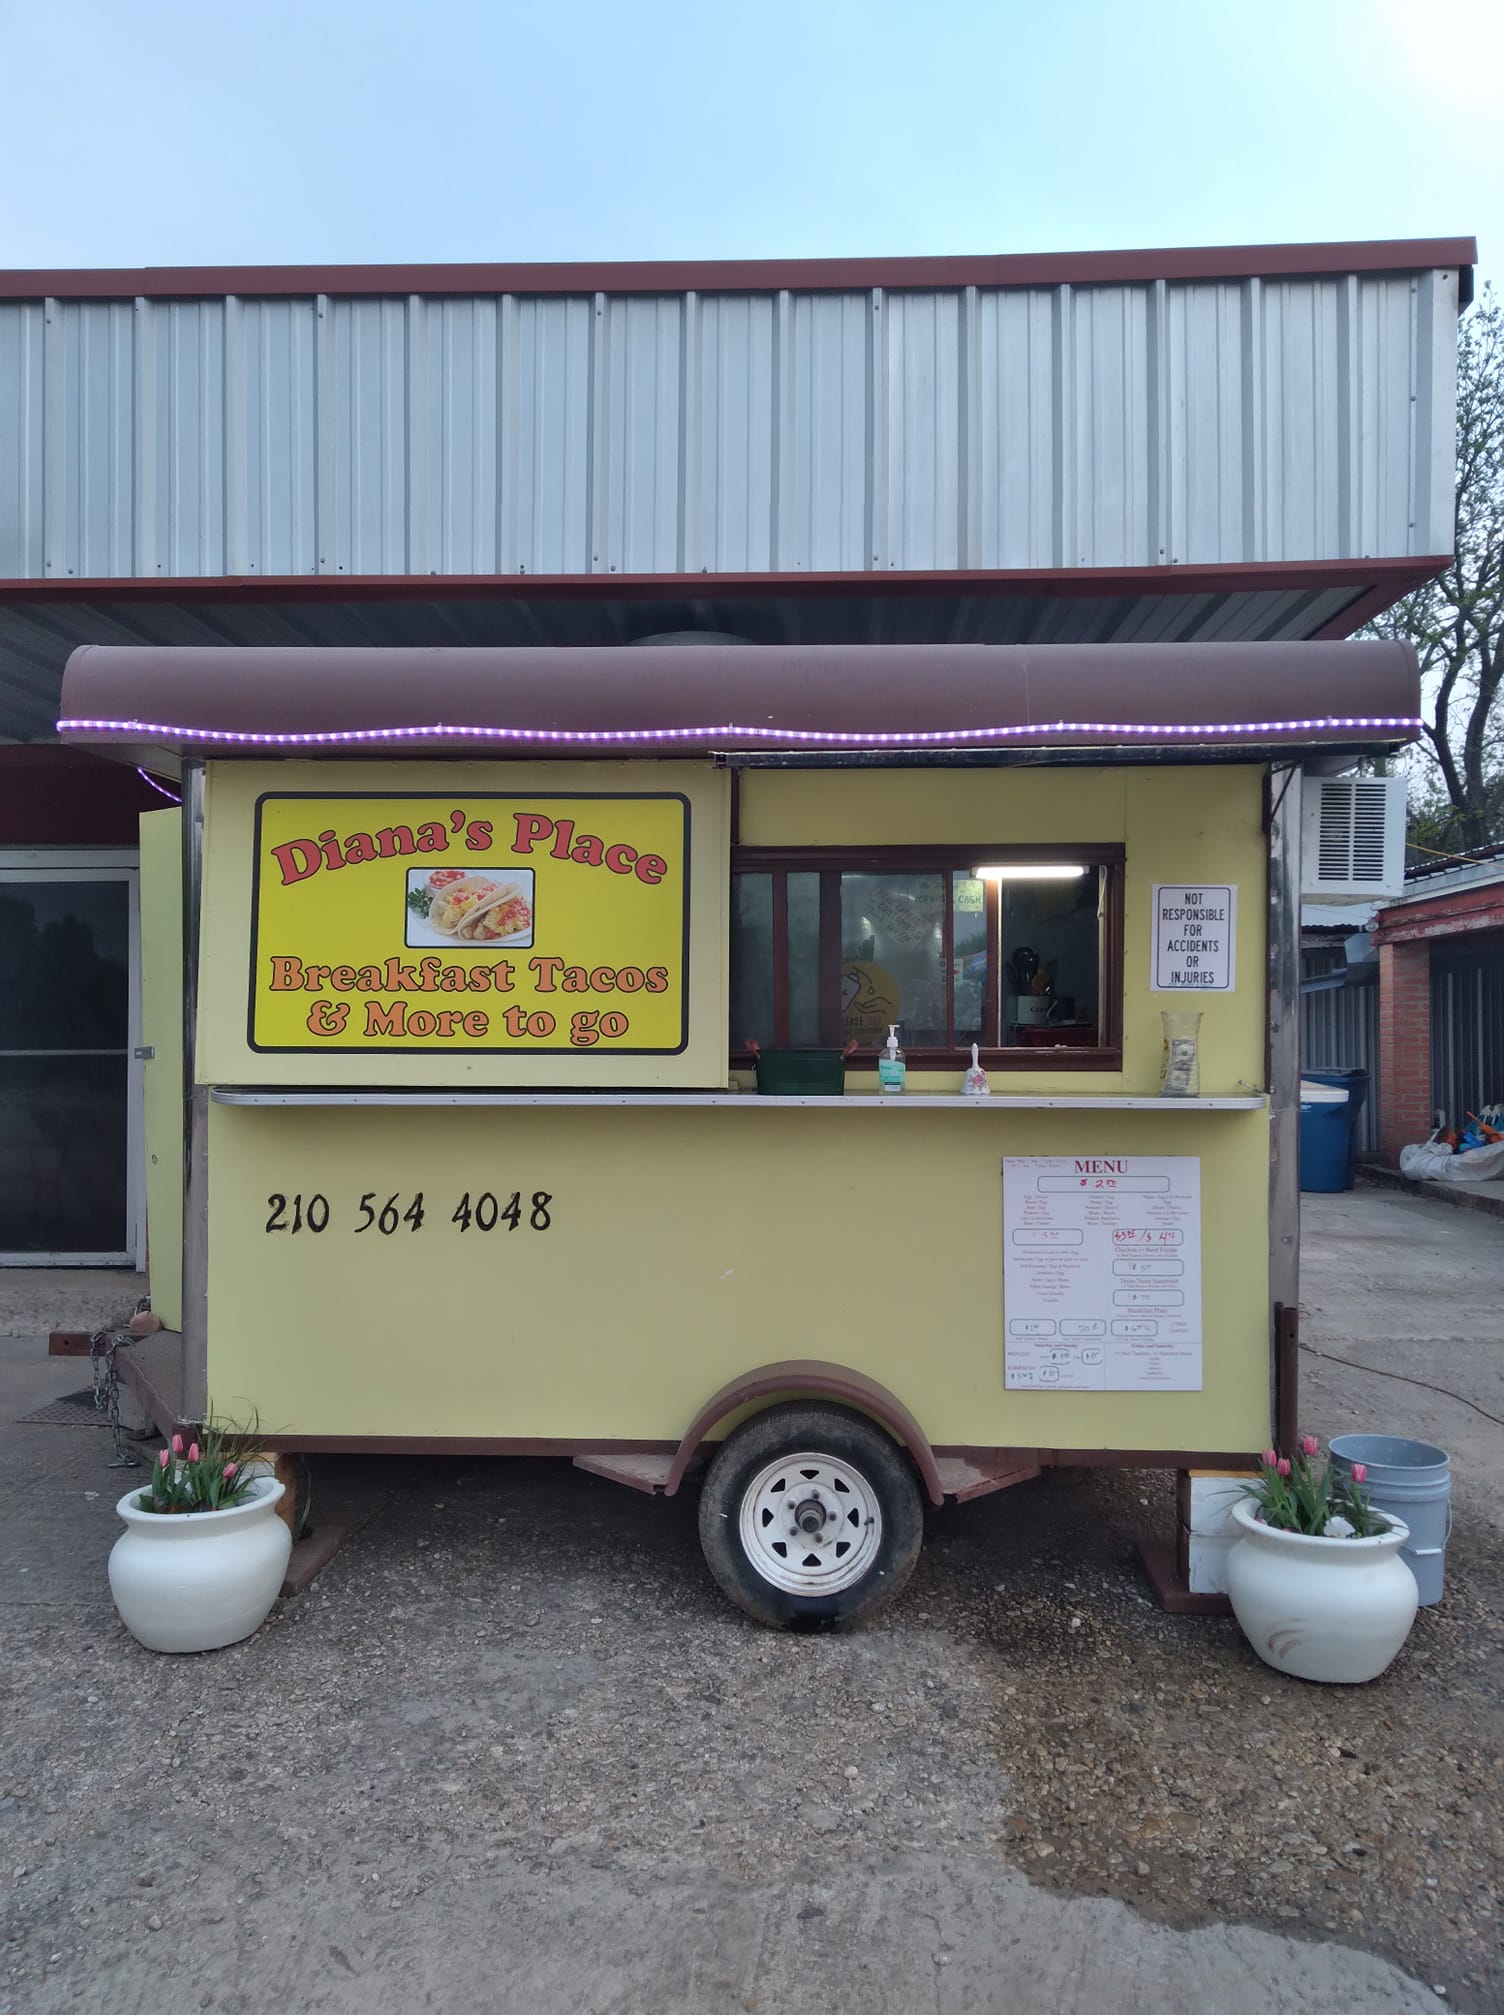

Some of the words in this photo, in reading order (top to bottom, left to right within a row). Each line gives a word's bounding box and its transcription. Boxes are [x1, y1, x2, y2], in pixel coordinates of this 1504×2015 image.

[271, 810, 493, 886] Diana's
[511, 812, 668, 885] Place
[958, 895, 982, 904] CASH
[1185, 893, 1203, 905] NOT
[1162, 909, 1225, 921] RESPONSIBLE
[1184, 924, 1202, 936] FOR
[1167, 940, 1219, 952] ACCIDENTS
[1186, 956, 1199, 968] OR
[269, 956, 515, 993] Breakfast
[529, 957, 669, 993] Tacos
[1171, 971, 1215, 984] INJURIES
[307, 1000, 351, 1037] &
[363, 1001, 489, 1037] More
[503, 1005, 556, 1037] to
[570, 1011, 629, 1046] go
[1074, 1159, 1128, 1174] MENU
[265, 1193, 330, 1235] 210
[354, 1192, 425, 1235] 564
[451, 1191, 553, 1233] 4048
